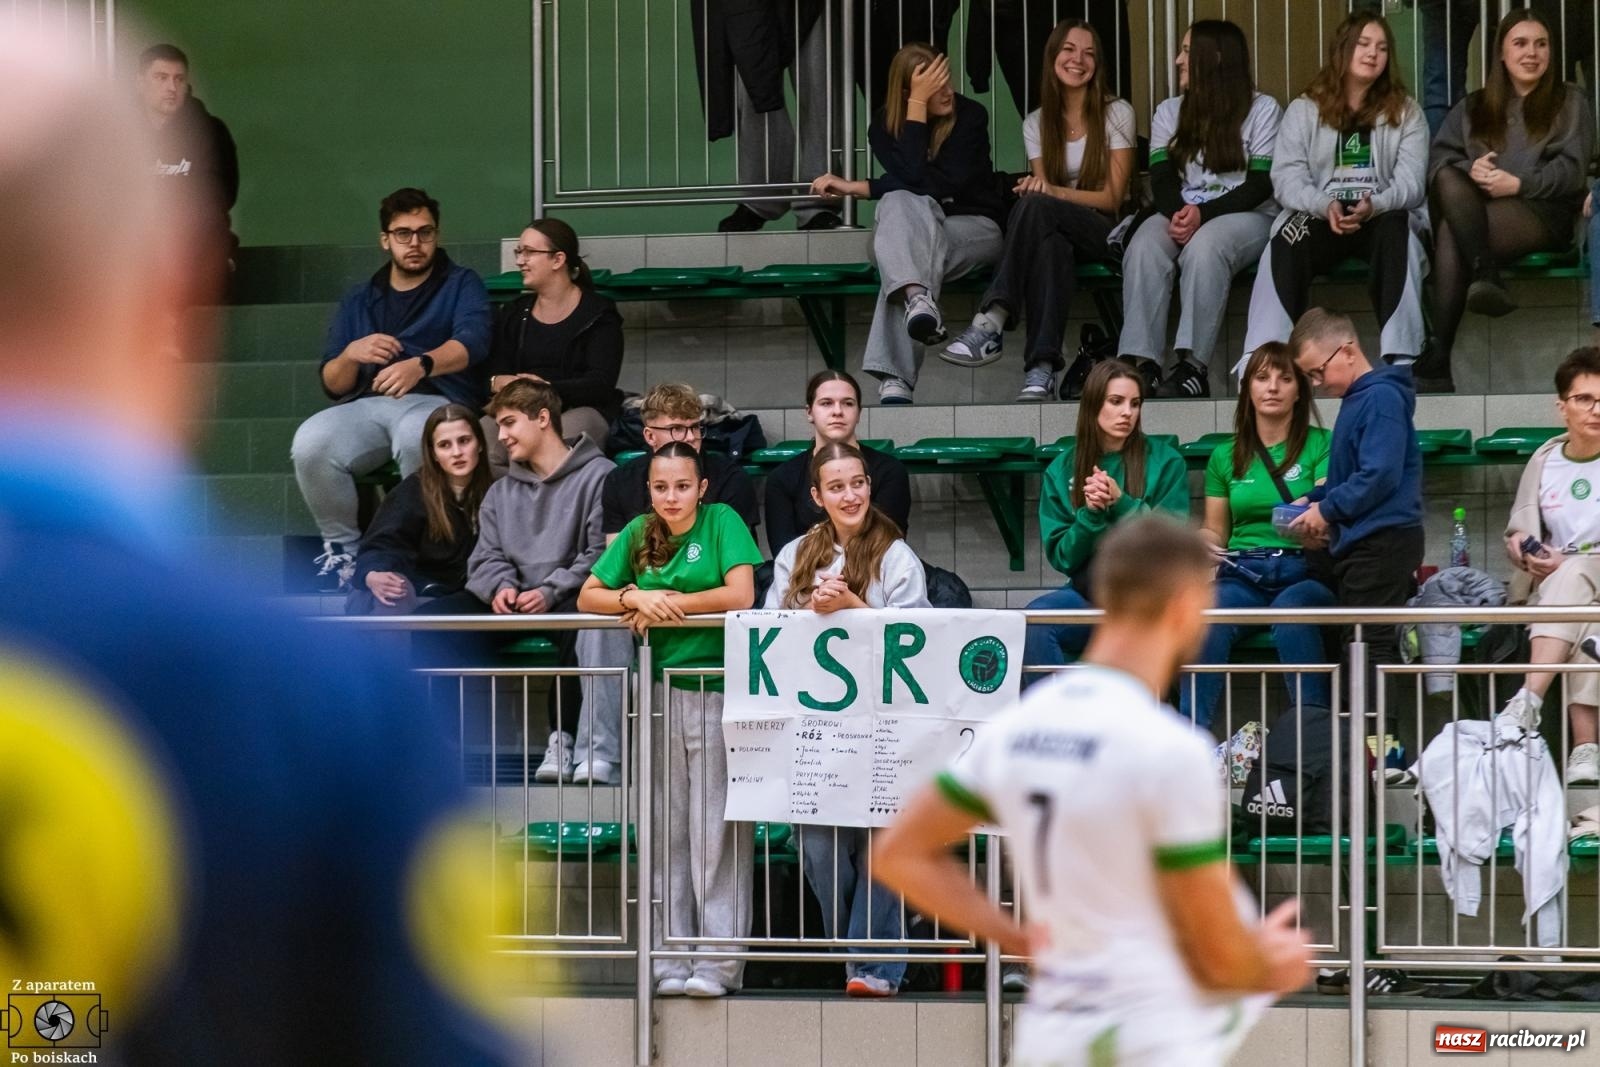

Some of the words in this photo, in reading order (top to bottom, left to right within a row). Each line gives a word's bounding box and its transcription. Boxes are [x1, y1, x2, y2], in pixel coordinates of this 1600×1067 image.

[1345, 132, 1361, 154] 4
[748, 622, 930, 712] KSR
[734, 720, 786, 731] TRENERZY
[801, 728, 823, 741] RÓŻ
[1247, 802, 1294, 818] addas
[1026, 790, 1056, 898] 7
